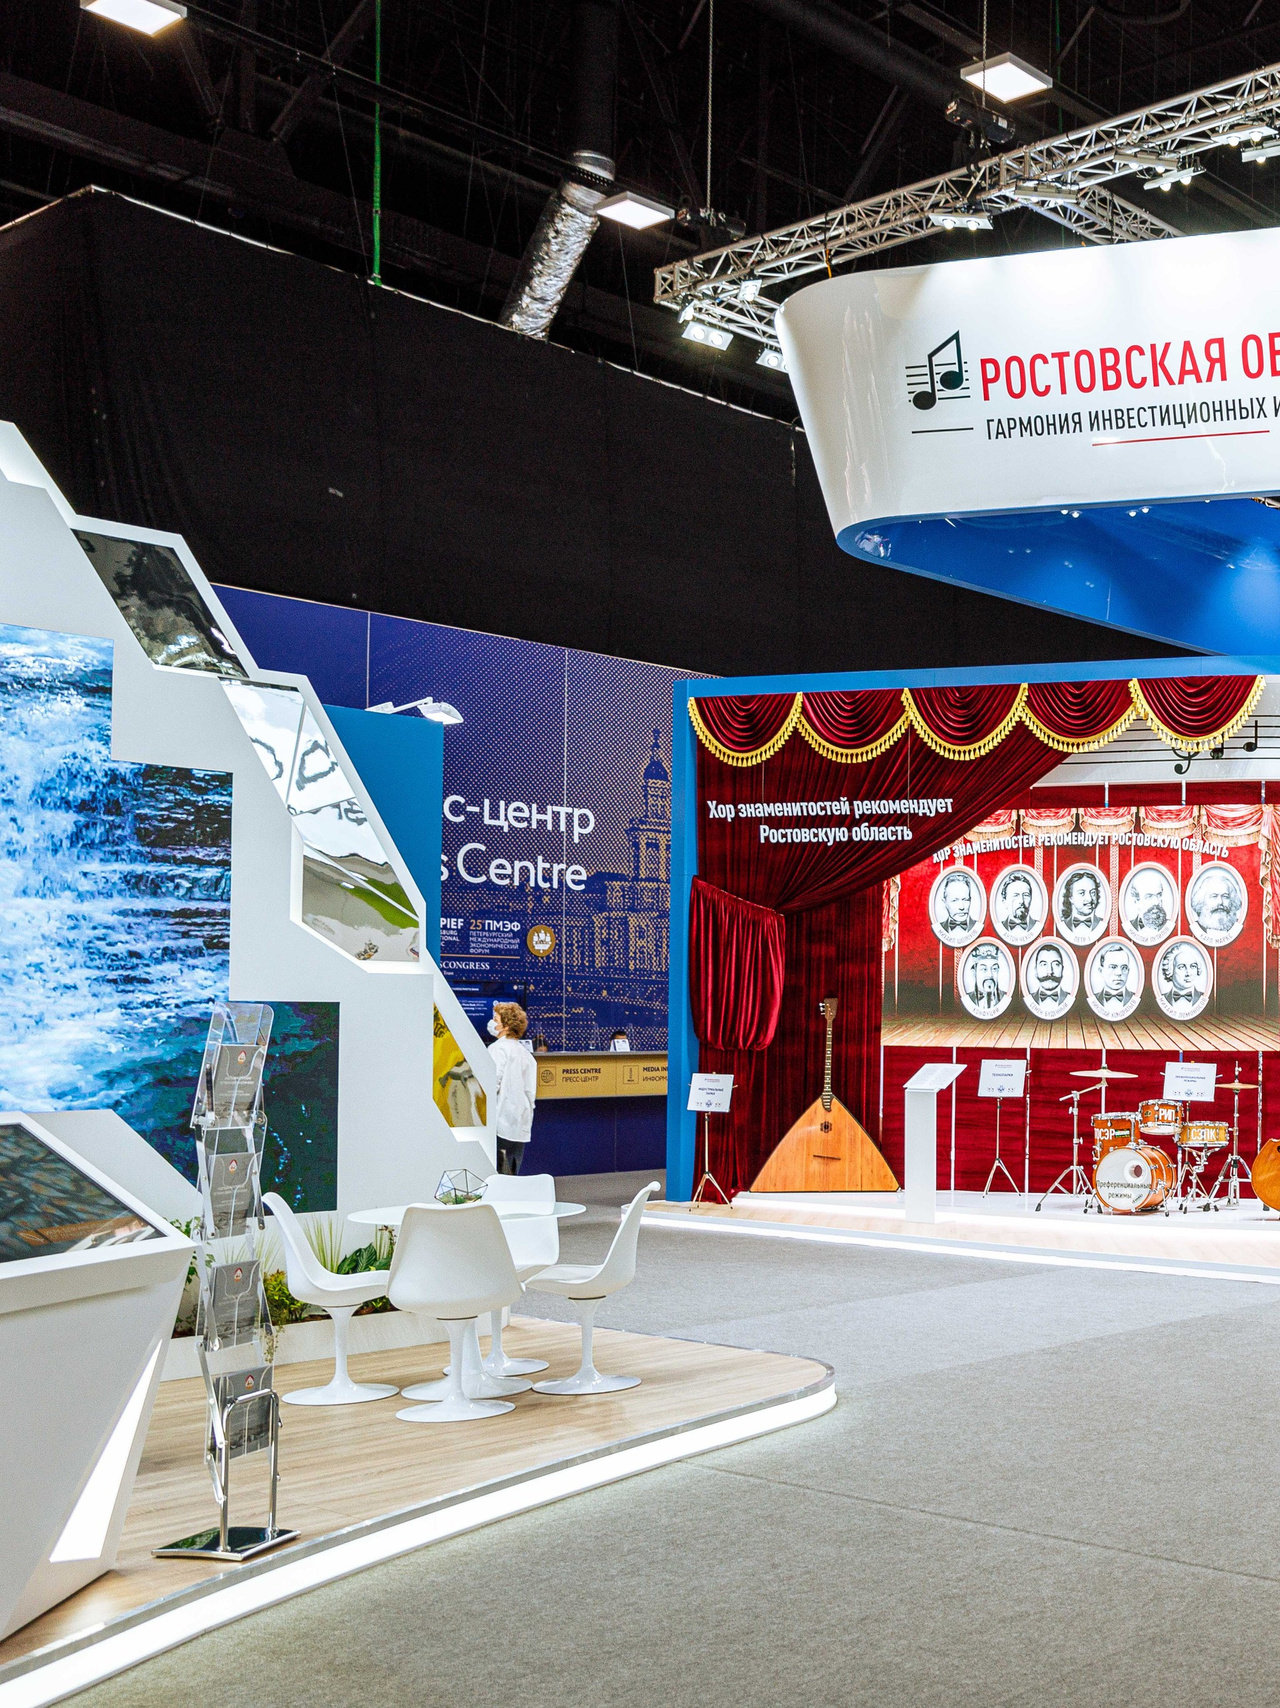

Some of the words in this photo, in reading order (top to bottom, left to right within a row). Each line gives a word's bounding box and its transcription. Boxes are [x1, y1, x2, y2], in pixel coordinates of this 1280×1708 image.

[980, 337, 1227, 401] РОСТОВСКАЯ
[986, 411, 1082, 440] ГАРМОНИЯ
[1089, 397, 1267, 431] ИНВЕСТИЦИОННЫХ
[707, 800, 735, 822] Хор
[738, 797, 850, 818] знаменитостей
[853, 798, 953, 819] рекомендует
[760, 824, 848, 846] Ростовскую
[851, 823, 913, 841] область
[952, 833, 1035, 858] ЗНАМЕНИТОСТЕЙ
[1038, 832, 1110, 847] РЕКОМЕНДУЕТ
[1111, 832, 1180, 849] РОСТОВСКУЮ
[1182, 838, 1229, 858] ОБЛАСТЬ
[457, 843, 587, 890] Centre
[485, 920, 521, 932] ПМЭФ
[1159, 1108, 1176, 1121] РИП
